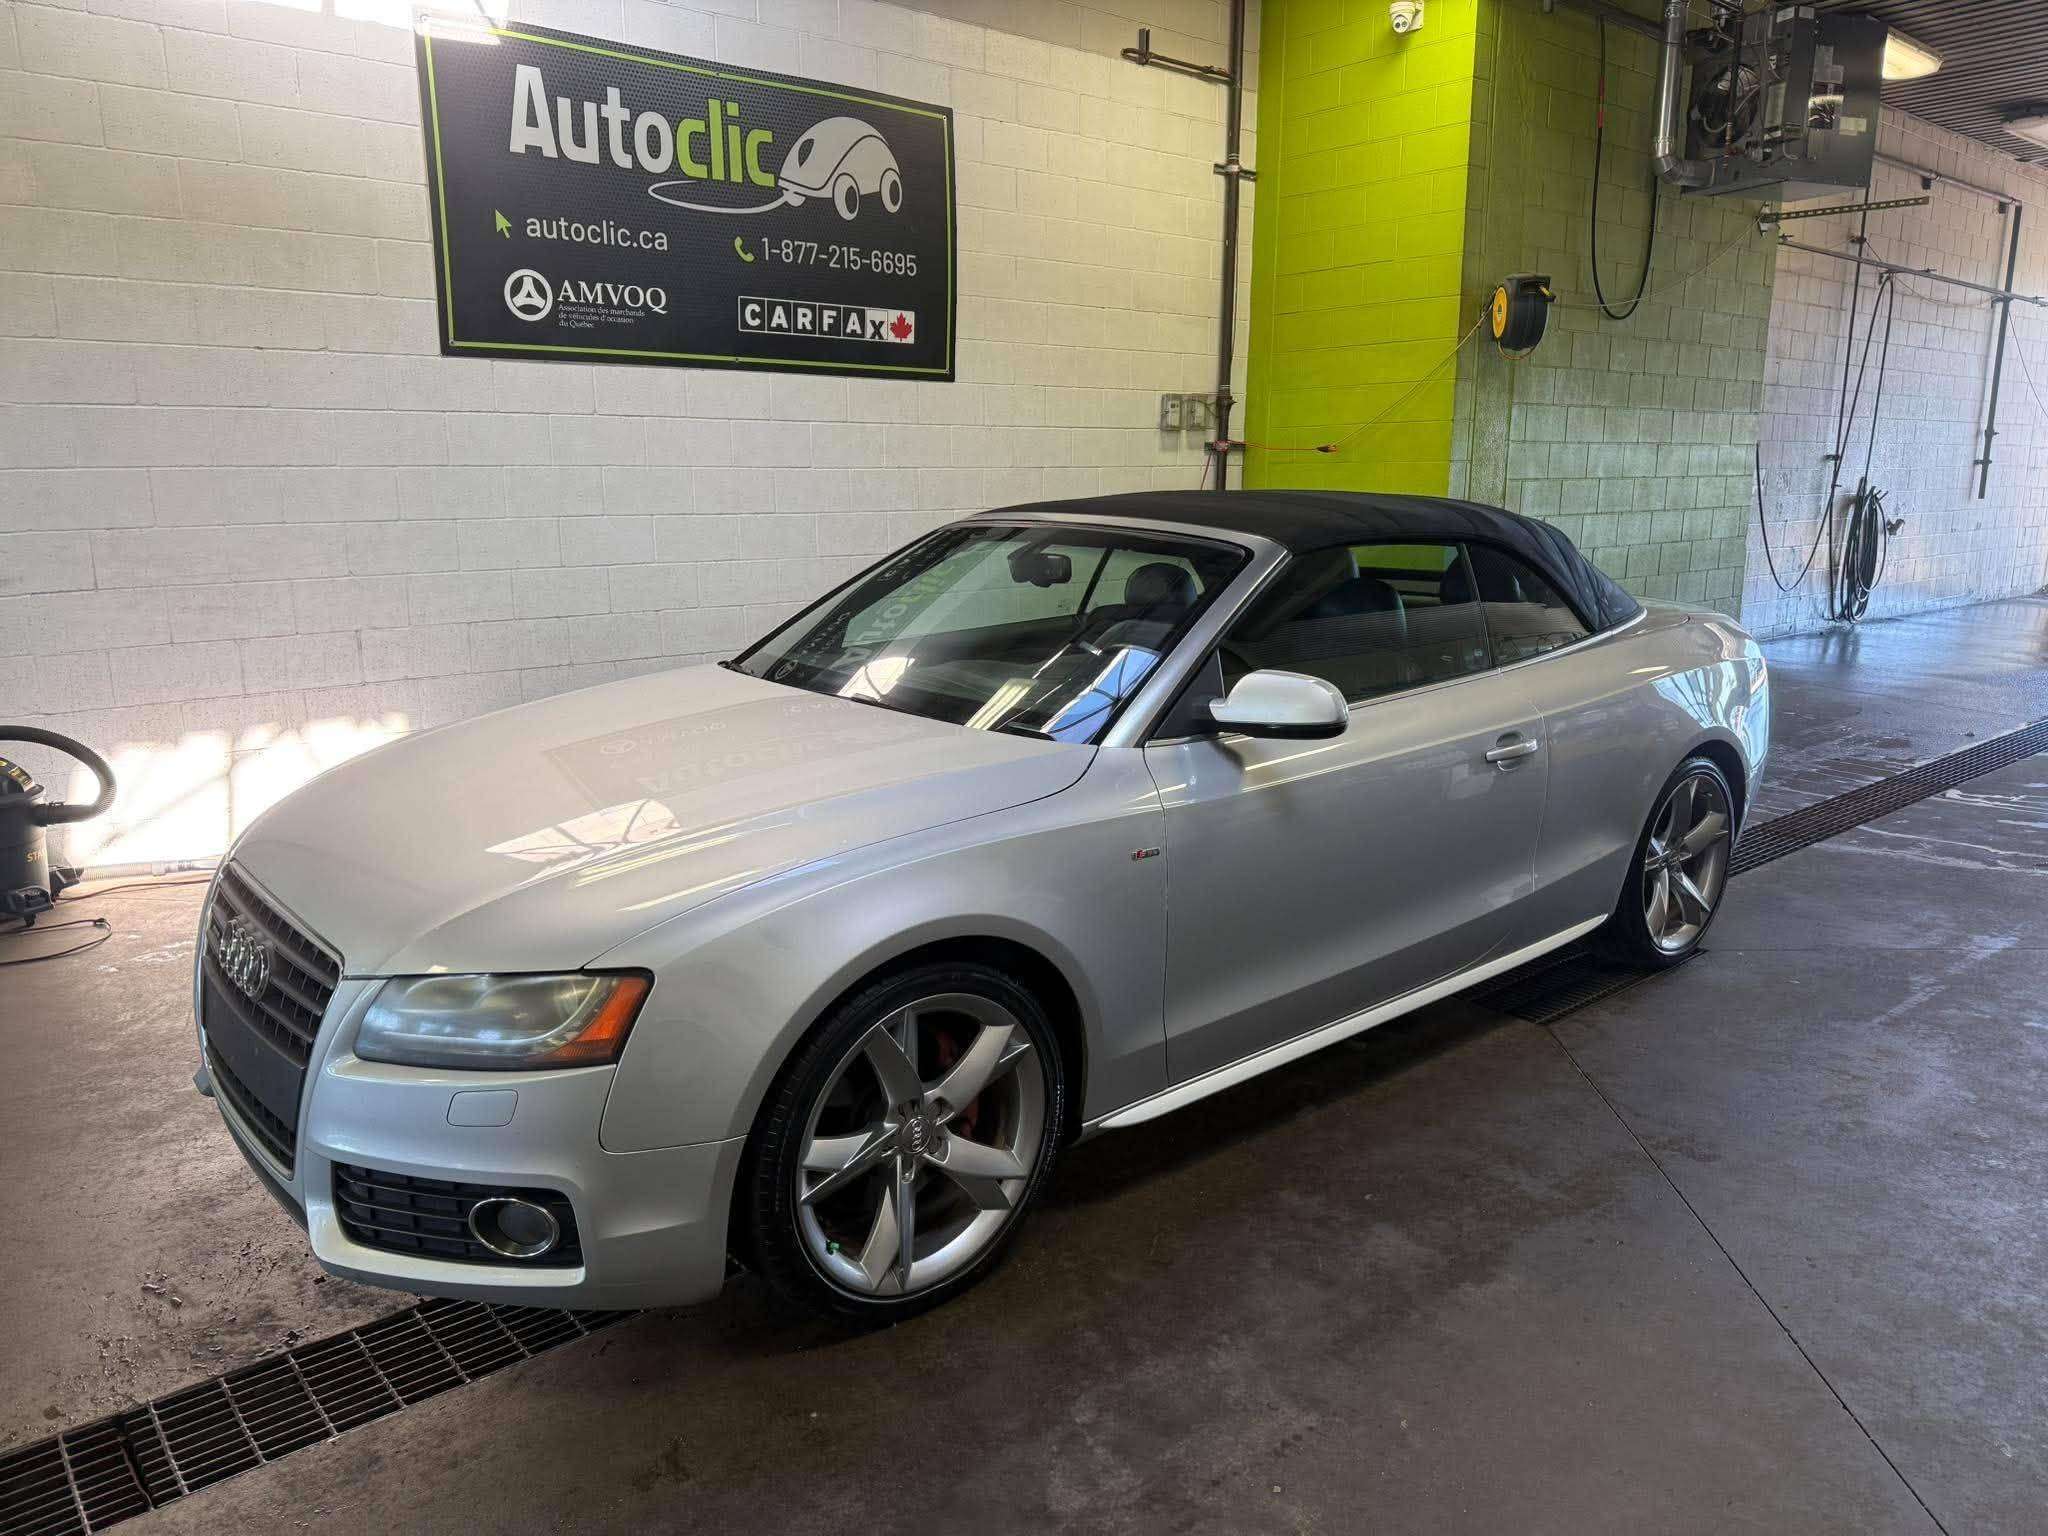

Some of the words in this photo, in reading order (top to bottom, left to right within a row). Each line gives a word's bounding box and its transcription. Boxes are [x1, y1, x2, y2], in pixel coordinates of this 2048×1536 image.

[510, 63, 775, 188] Autoclic
[526, 216, 669, 251] autoclic.ca
[761, 237, 917, 277] 1-877-215-6695
[556, 279, 668, 315] AMVOQ
[558, 304, 597, 314] Association
[597, 306, 609, 314] des
[609, 308, 645, 317] marchands
[744, 303, 886, 340] CARFAX
